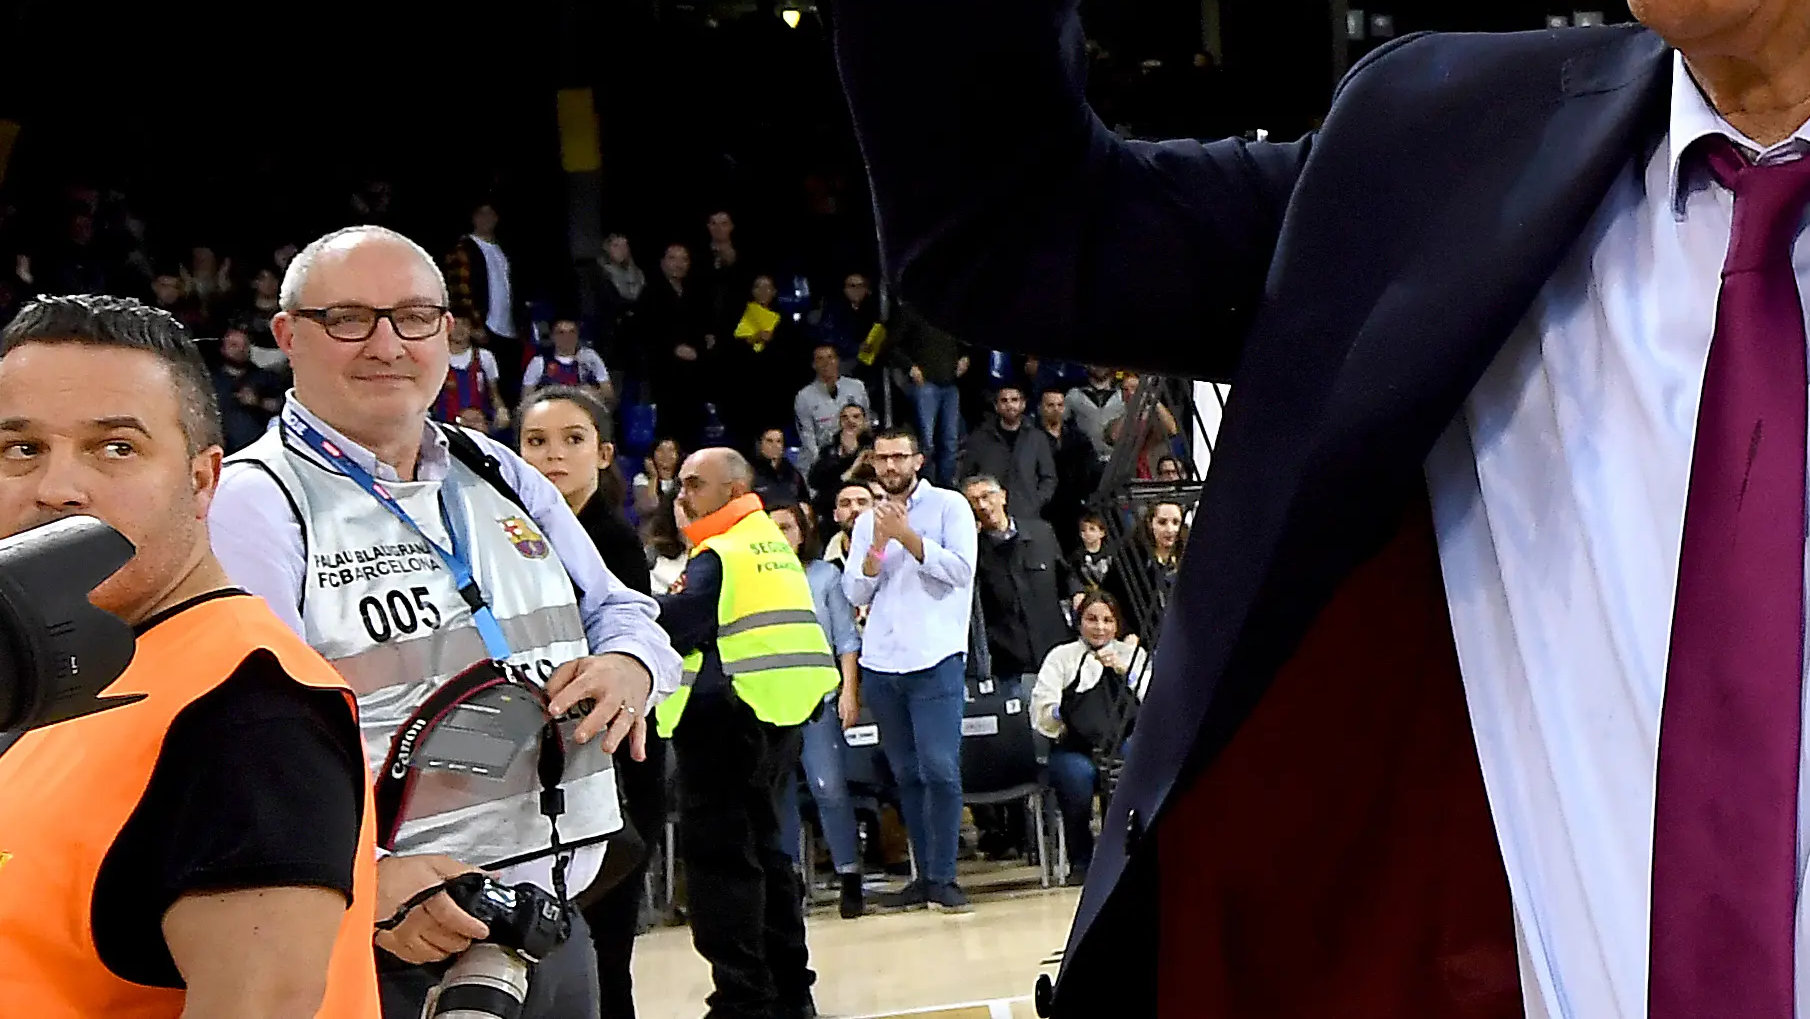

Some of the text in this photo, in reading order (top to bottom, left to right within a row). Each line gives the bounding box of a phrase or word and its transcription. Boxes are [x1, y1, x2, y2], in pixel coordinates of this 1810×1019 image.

[314, 549, 354, 569] PALAU
[359, 586, 441, 643] 005
[391, 718, 427, 780] Canon
